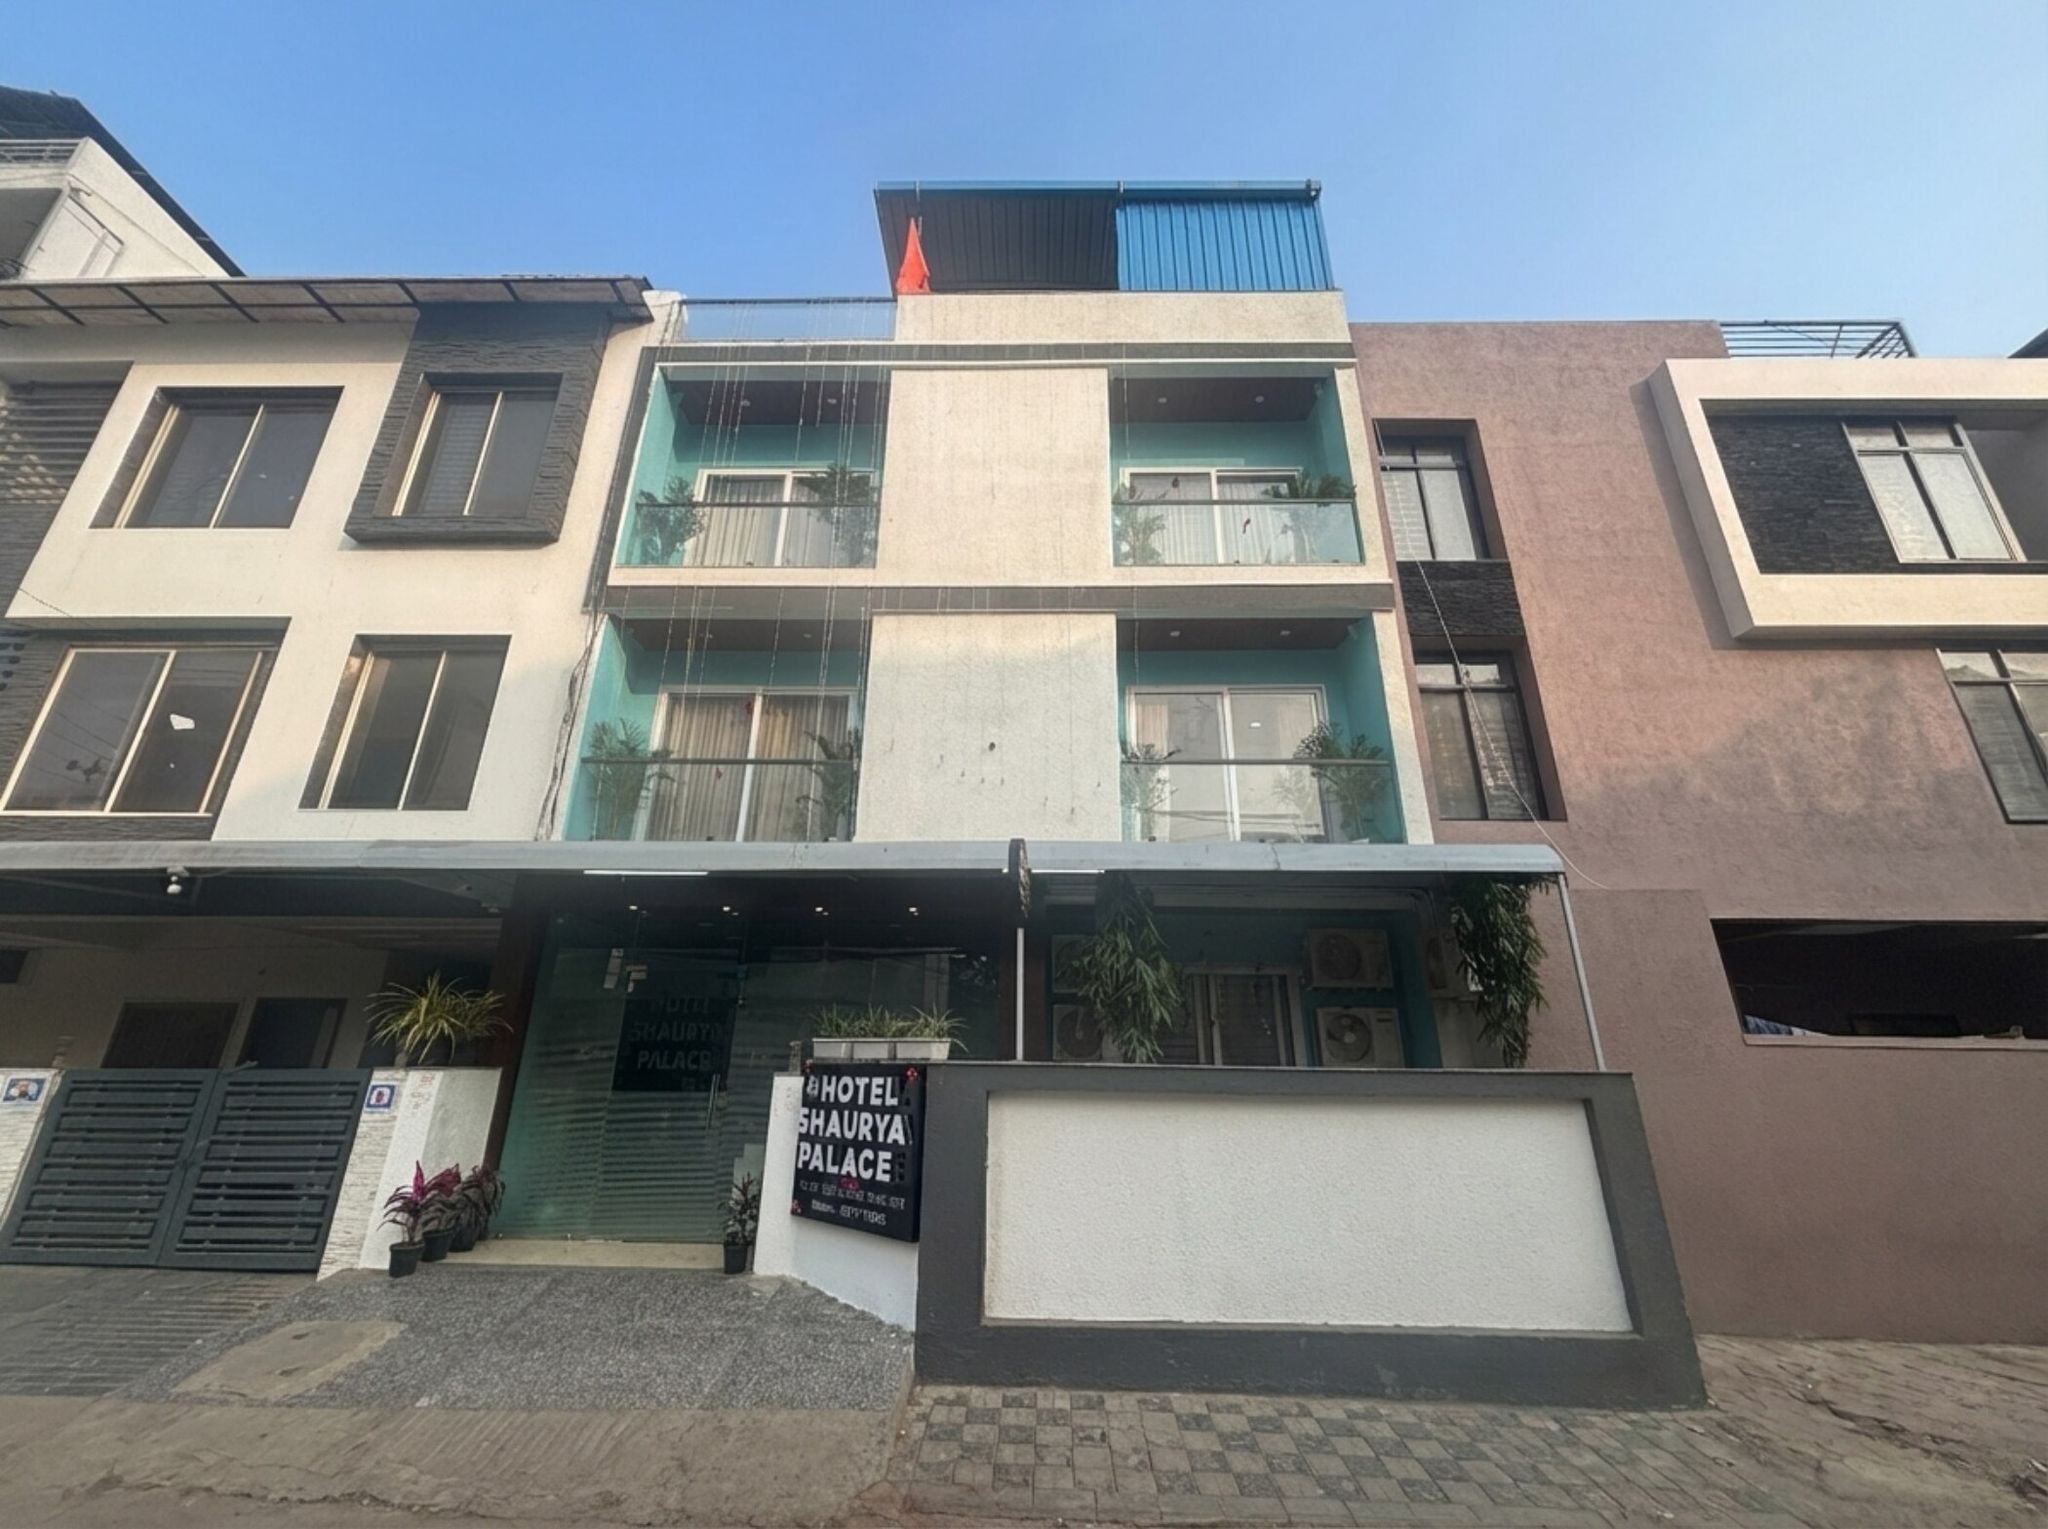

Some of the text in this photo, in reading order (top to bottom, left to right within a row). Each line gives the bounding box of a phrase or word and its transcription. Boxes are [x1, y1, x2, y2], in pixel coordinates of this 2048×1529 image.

[820, 1075, 899, 1106] HOTEL
[798, 1107, 906, 1146] SHAURYA
[797, 1141, 892, 1183] PALACE
